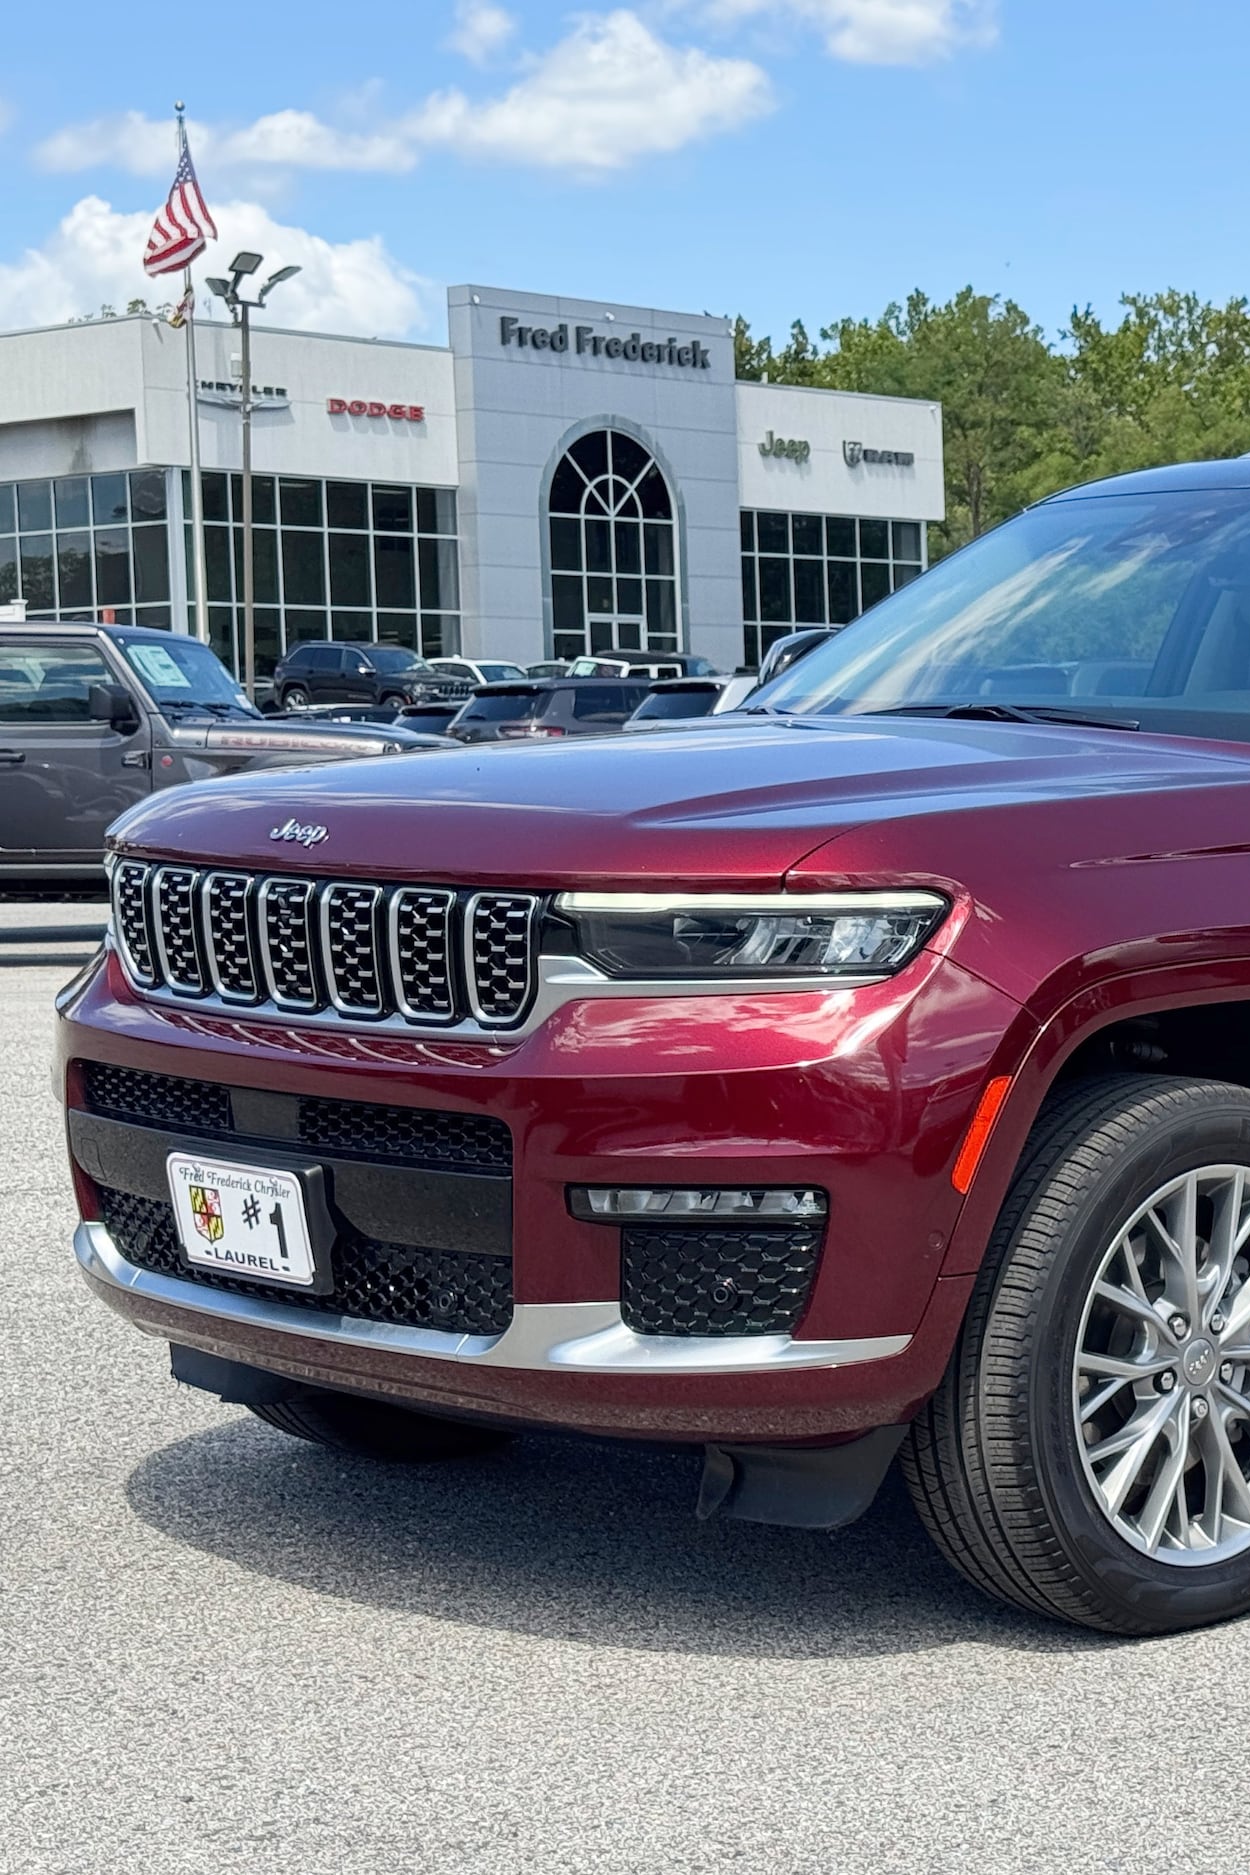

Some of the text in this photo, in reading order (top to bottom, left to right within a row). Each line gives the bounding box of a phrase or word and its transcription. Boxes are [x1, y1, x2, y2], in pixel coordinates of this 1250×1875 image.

[500, 316, 711, 370] Fred Frederick
[195, 379, 288, 397] HRYLER
[327, 398, 425, 423] DODGE
[757, 430, 811, 466] Jeep
[269, 817, 329, 848] Jeep
[178, 1166, 292, 1200] Fred Frederick Chrysler
